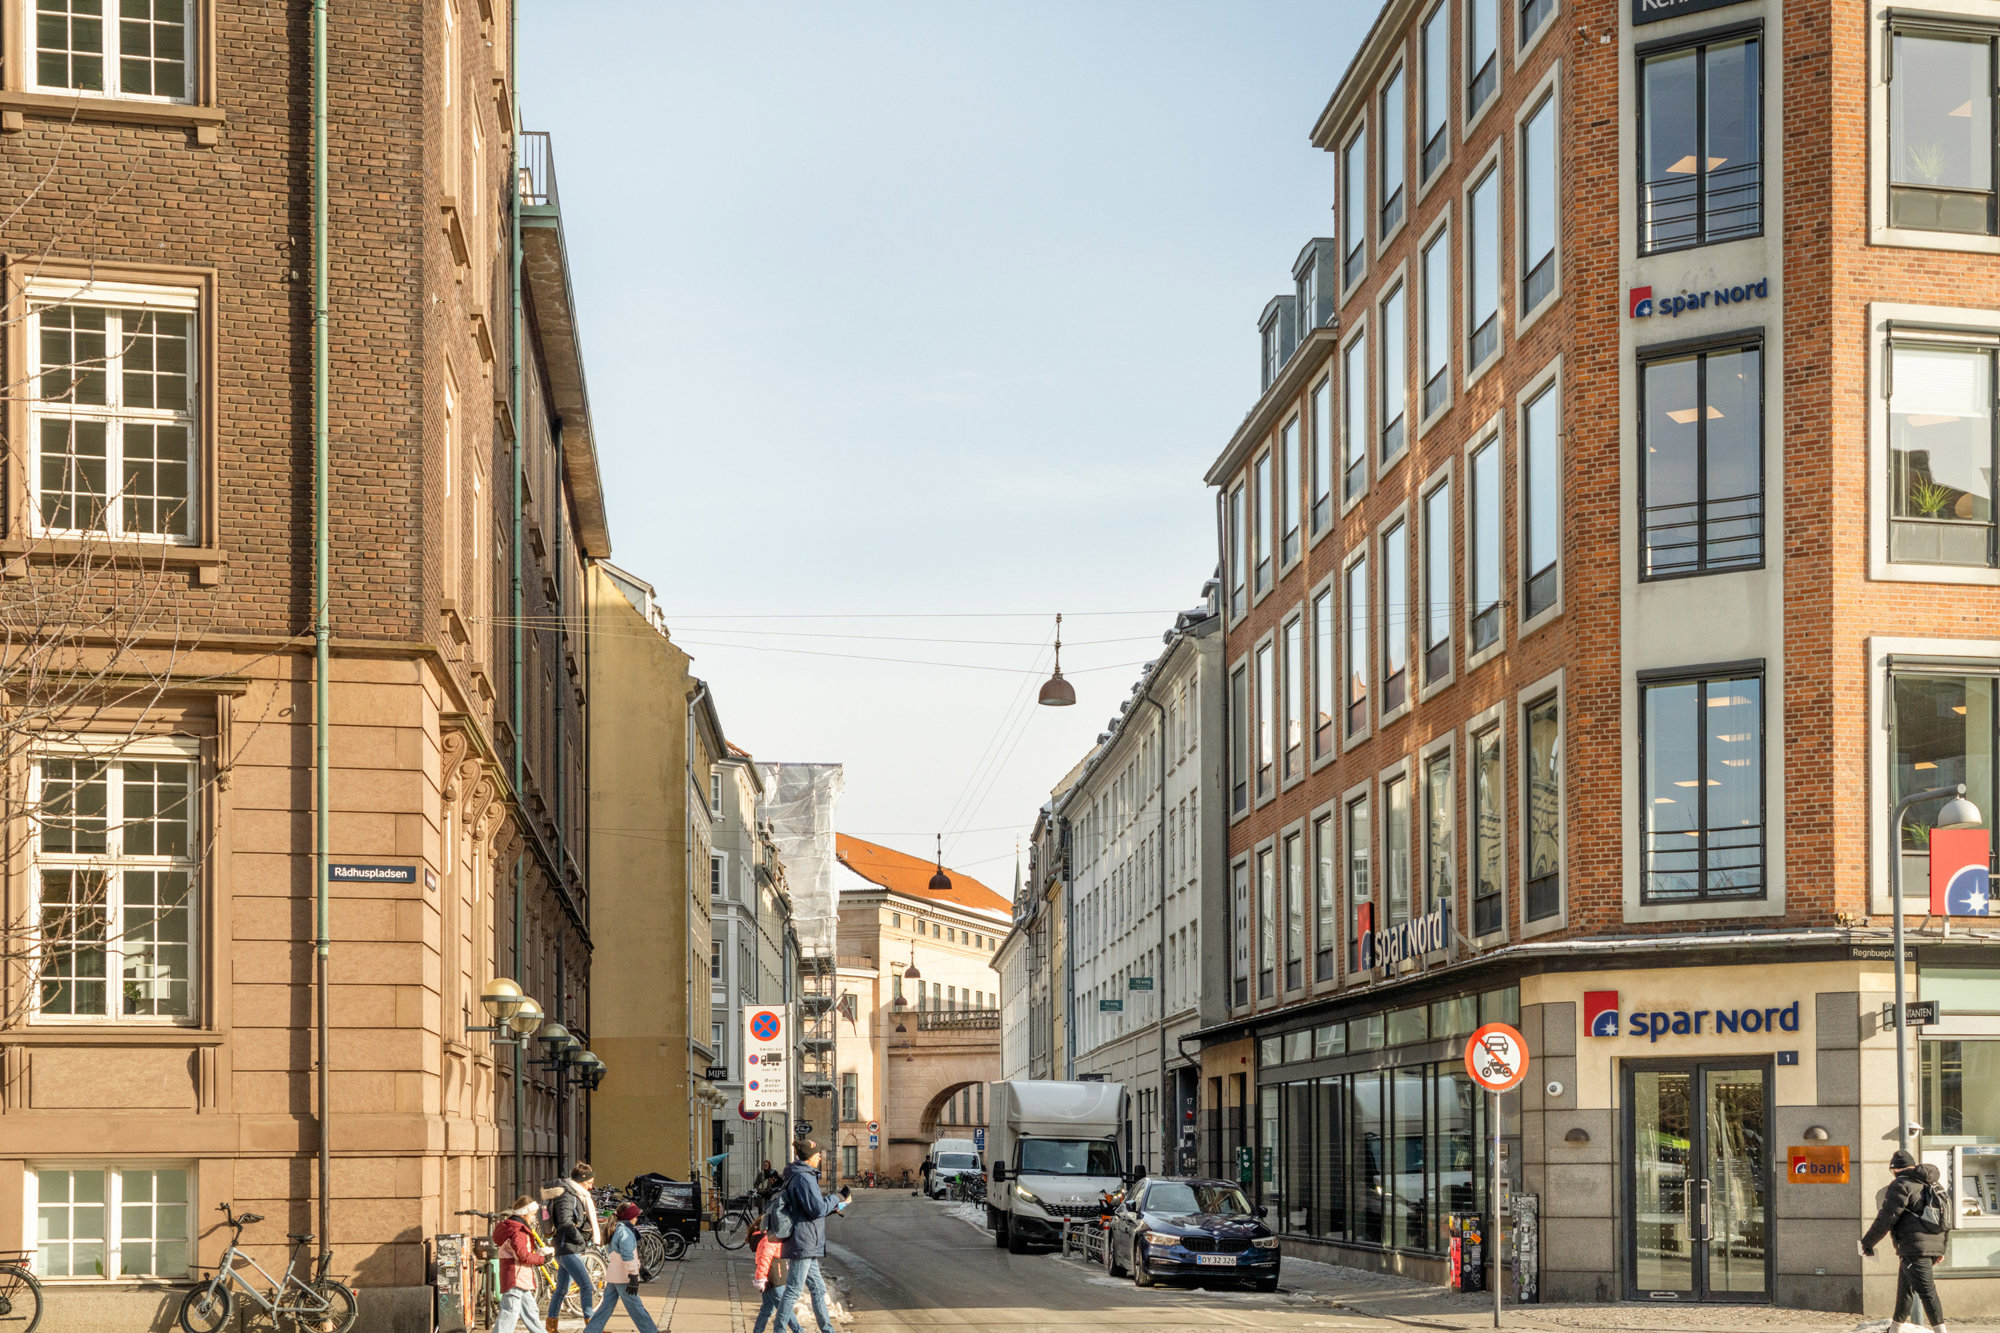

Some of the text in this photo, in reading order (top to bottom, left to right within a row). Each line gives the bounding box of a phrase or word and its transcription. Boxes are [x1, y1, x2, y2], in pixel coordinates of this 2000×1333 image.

[334, 866, 408, 880] Rådhuspladsen
[1852, 948, 1913, 959] Regnbueplaen
[1905, 1007, 1932, 1018] NTANTEN
[1785, 1053, 1791, 1063] 1
[1186, 1097, 1194, 1105] 17
[976, 1129, 984, 1138] P
[1810, 1162, 1846, 1174] bank
[1201, 1256, 1236, 1265] DY 32 326
